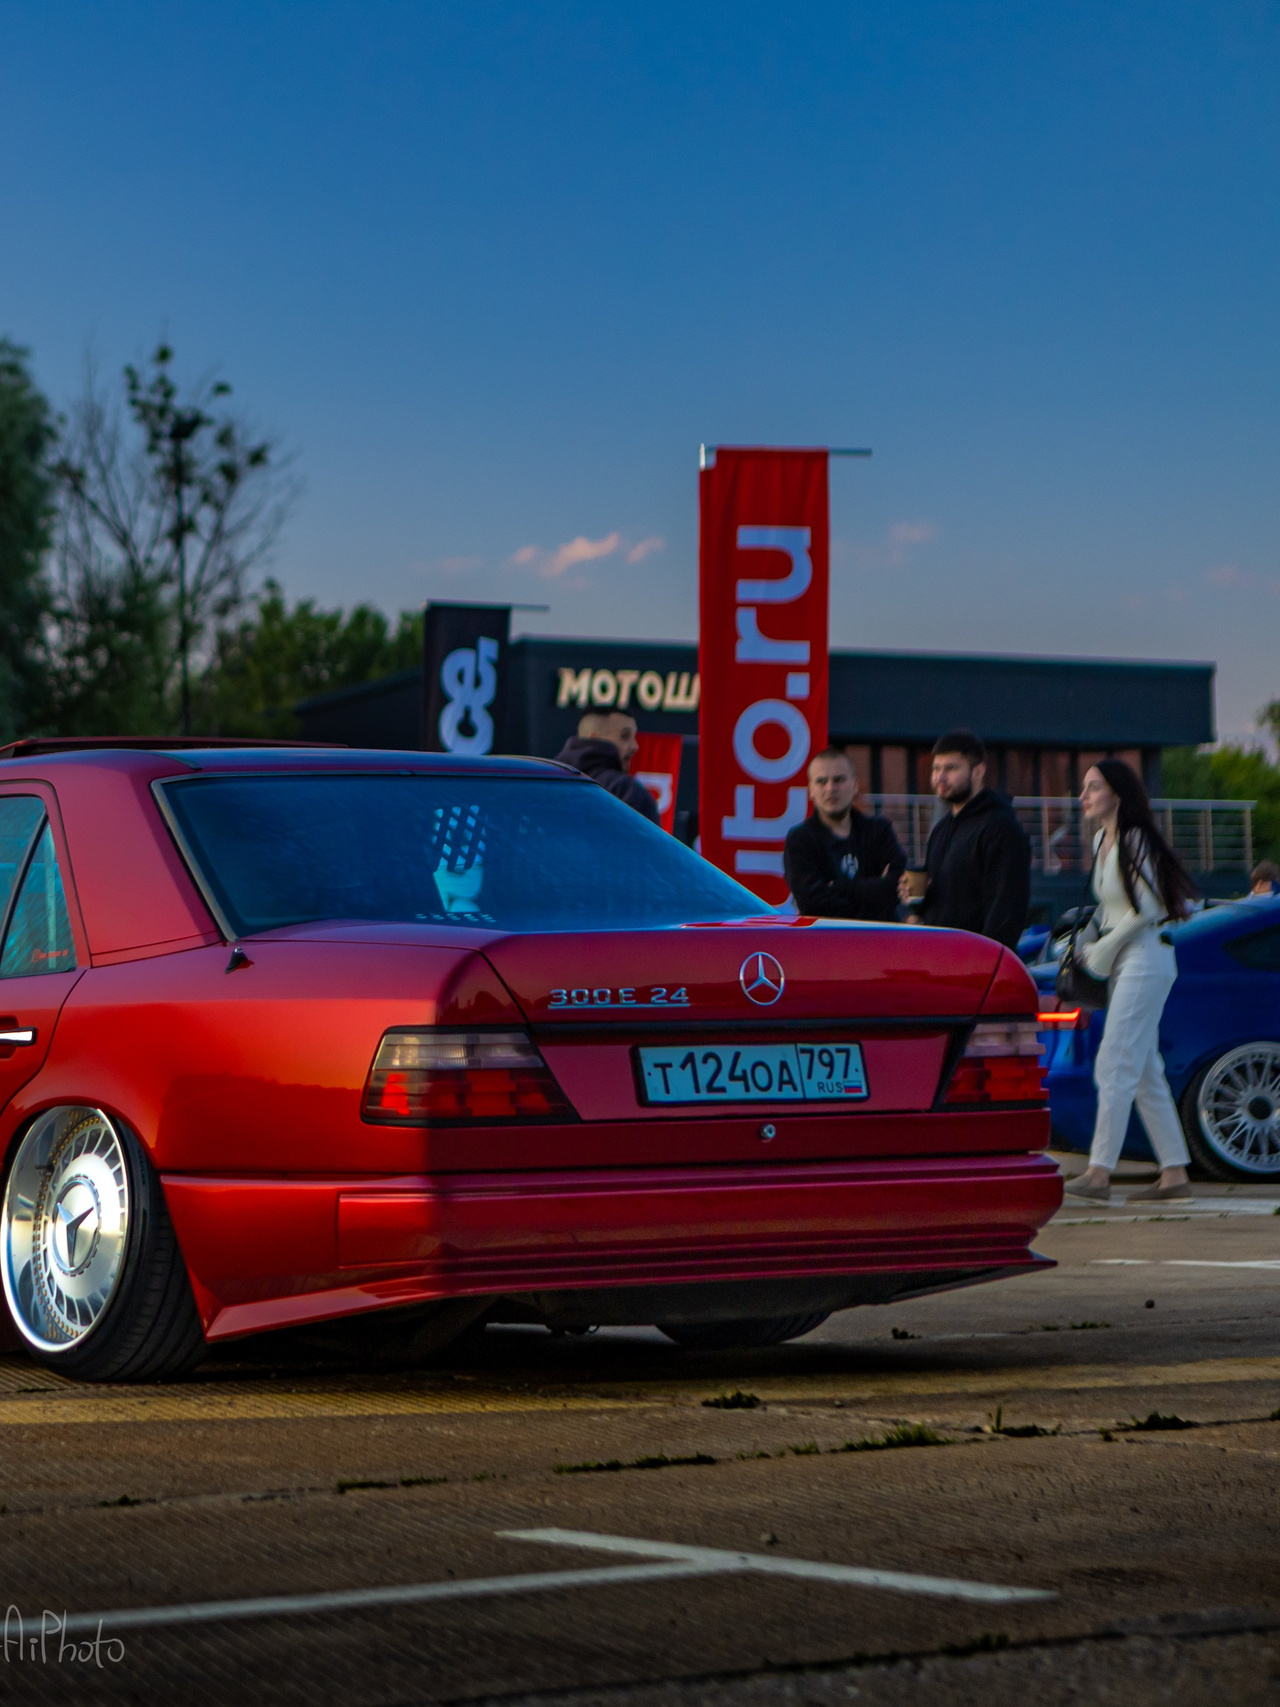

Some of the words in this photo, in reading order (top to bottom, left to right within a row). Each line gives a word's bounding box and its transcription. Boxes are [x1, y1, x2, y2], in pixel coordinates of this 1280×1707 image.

[650, 986, 690, 1004] 24
[799, 1047, 851, 1080] 797
[817, 1081, 844, 1094] RUS
